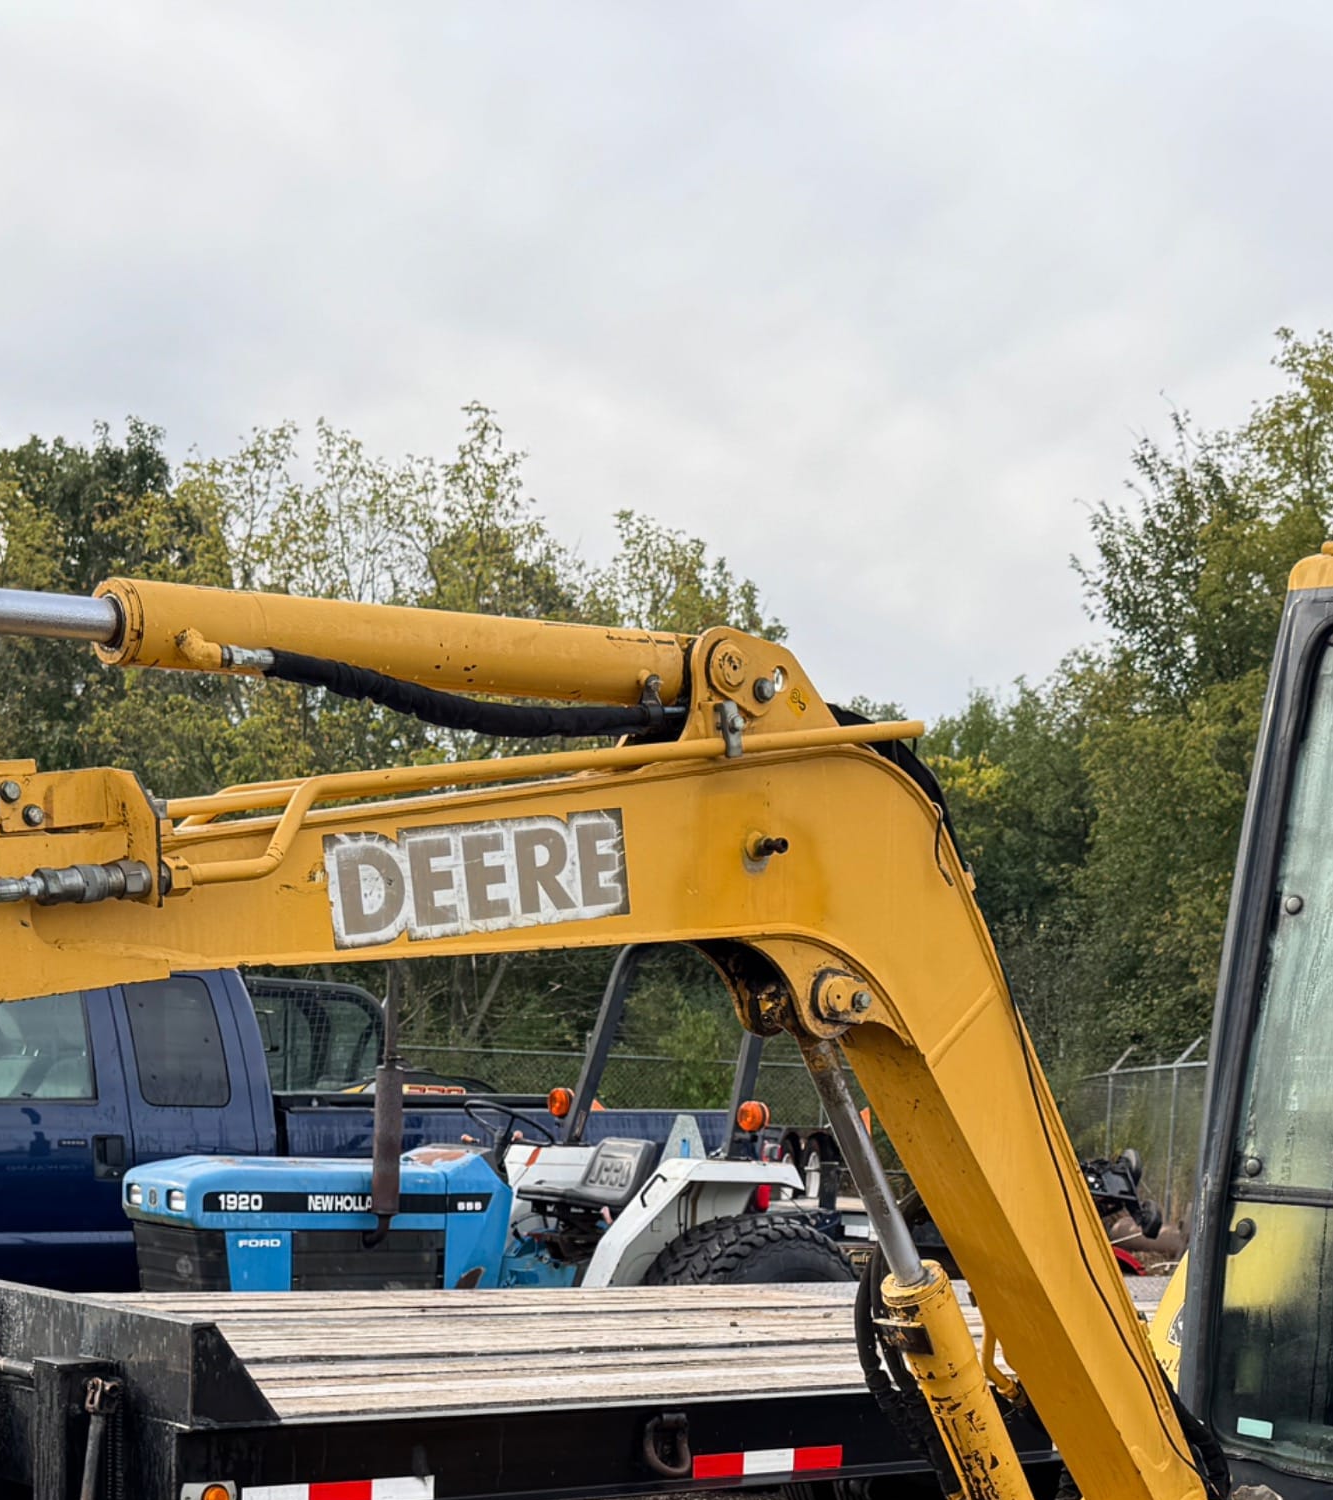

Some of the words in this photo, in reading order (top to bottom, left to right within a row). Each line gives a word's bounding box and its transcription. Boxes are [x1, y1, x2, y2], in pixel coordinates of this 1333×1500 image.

[332, 819, 624, 938] DEERE
[218, 1193, 264, 1211] 1920
[334, 1194, 373, 1212] HOLLA
[238, 1238, 282, 1249] FORD
